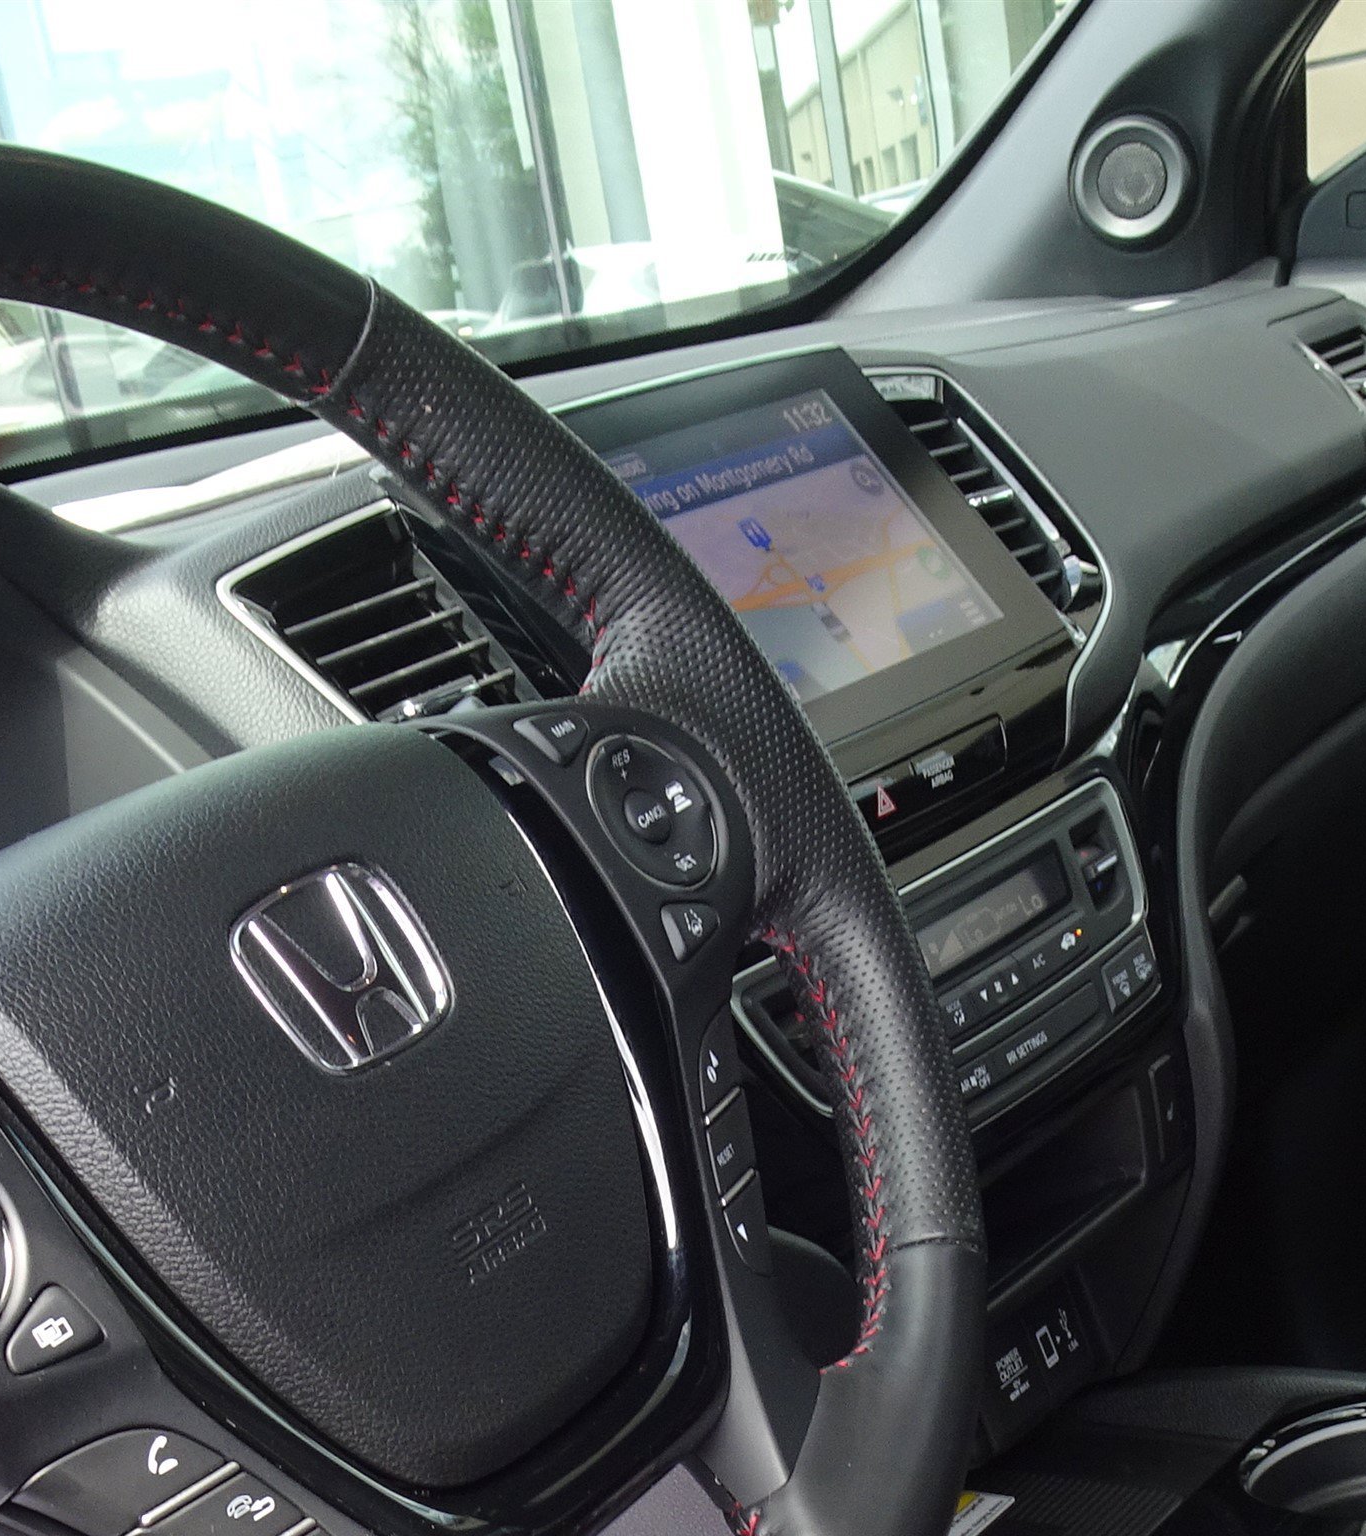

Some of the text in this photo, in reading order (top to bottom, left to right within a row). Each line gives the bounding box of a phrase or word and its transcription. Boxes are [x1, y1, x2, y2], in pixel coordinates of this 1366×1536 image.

[676, 482, 701, 503] on
[695, 455, 793, 494] Montgomery
[788, 442, 815, 466] Rd
[550, 718, 577, 739] MAIN
[611, 748, 631, 769] RES
[1016, 1030, 1048, 1060] SETTINGS
[716, 1142, 735, 1168] RESET
[995, 1346, 1021, 1373] POWER
[999, 1356, 1024, 1384] OUTLET
